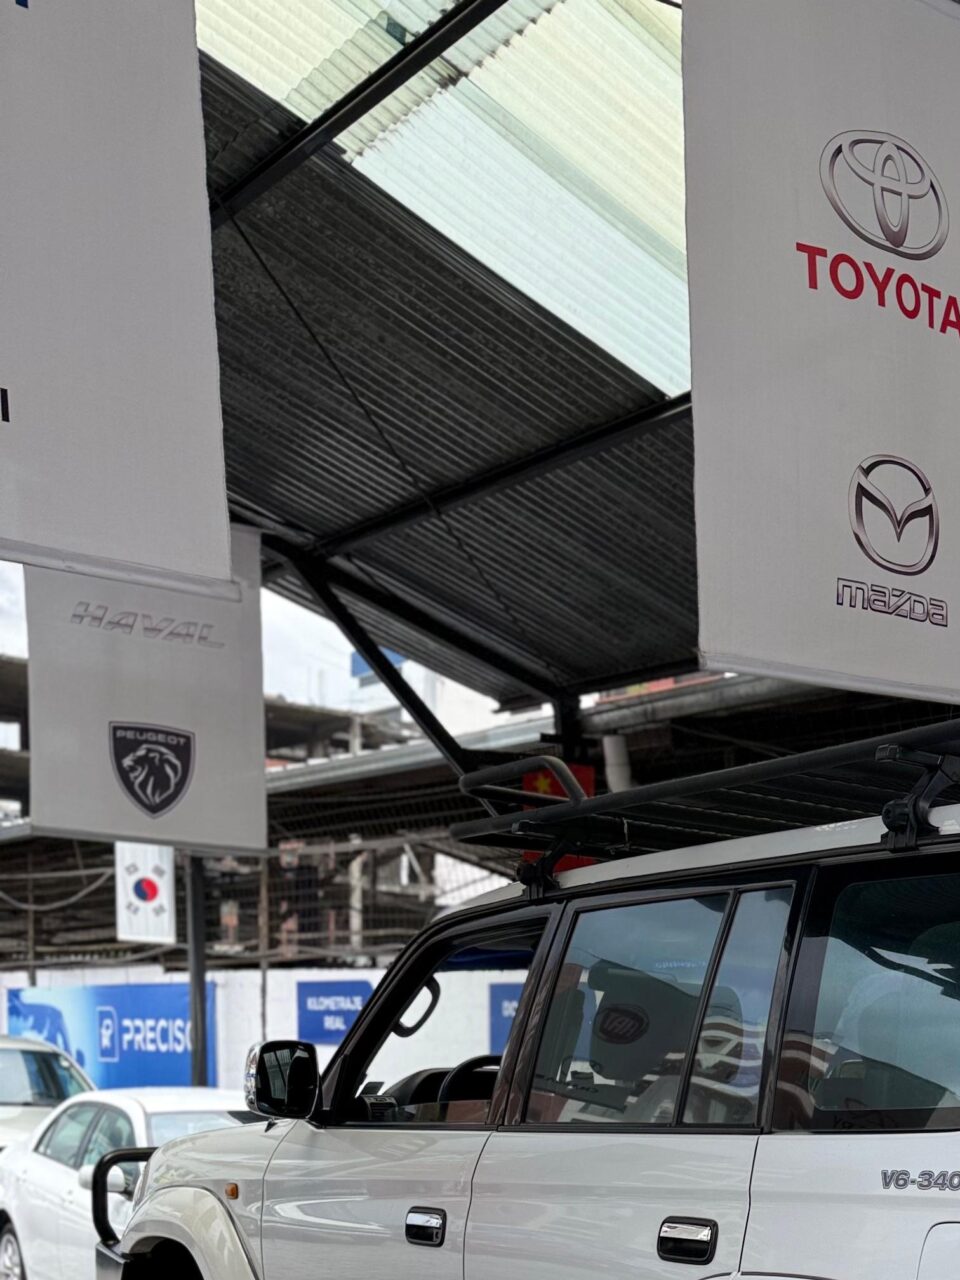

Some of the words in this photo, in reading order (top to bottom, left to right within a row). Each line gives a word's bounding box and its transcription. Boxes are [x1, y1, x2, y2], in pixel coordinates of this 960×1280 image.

[70, 601, 225, 648] HAVAL
[836, 577, 948, 627] mazda
[116, 729, 187, 746] PEUGEOT
